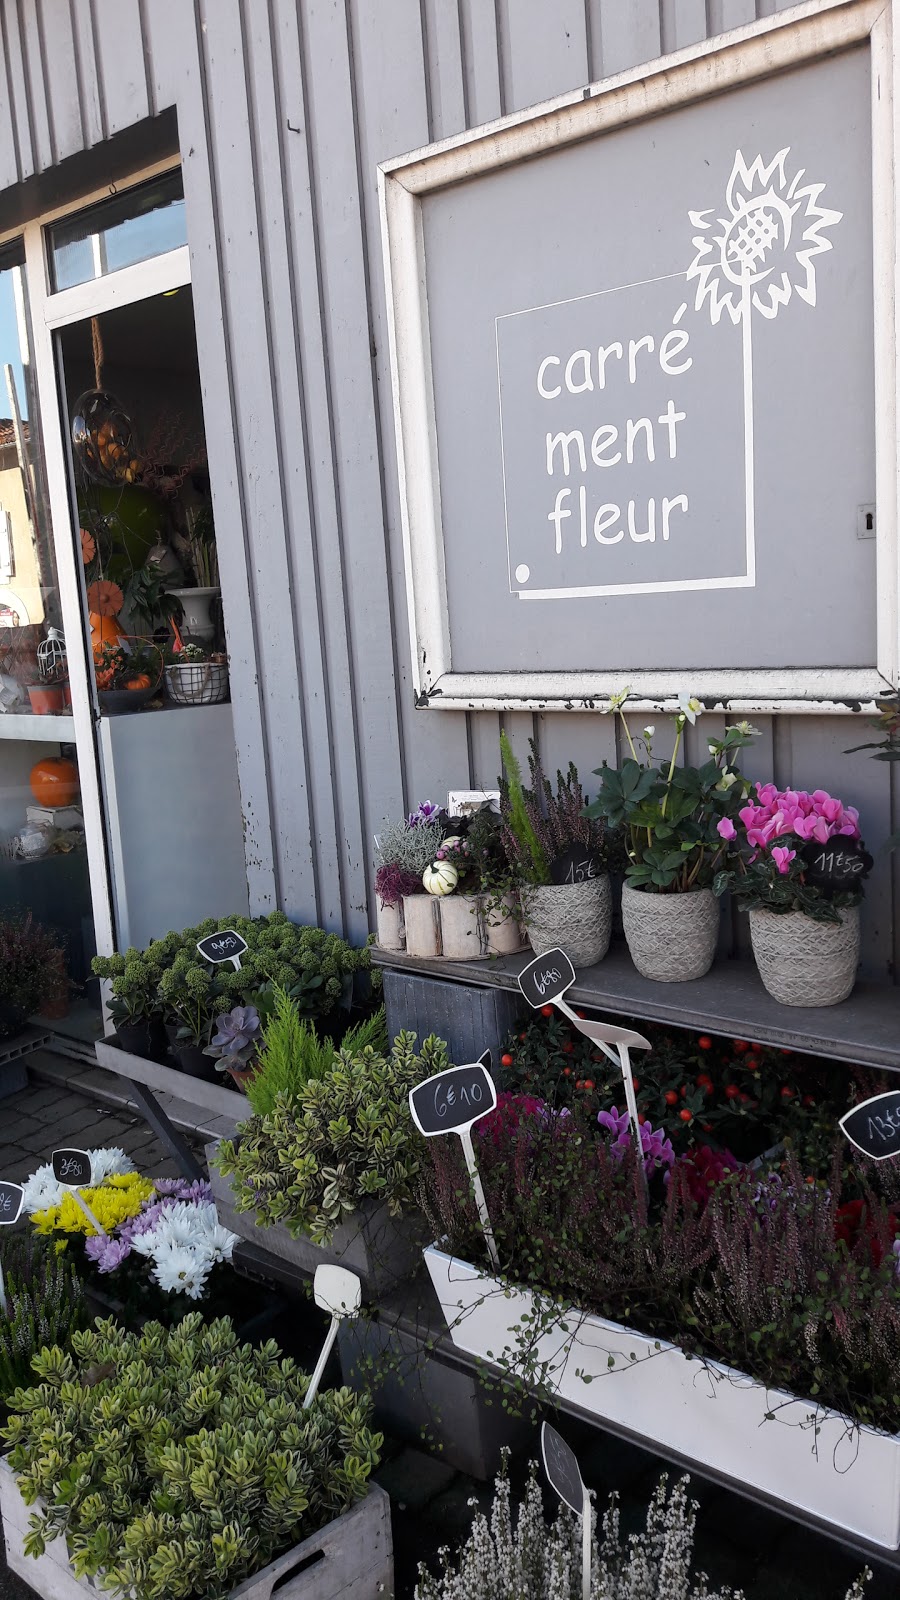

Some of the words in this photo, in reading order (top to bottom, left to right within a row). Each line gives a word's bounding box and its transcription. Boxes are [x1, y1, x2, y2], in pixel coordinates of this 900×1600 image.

[537, 302, 693, 399] carré
[546, 400, 686, 475] ment
[548, 486, 688, 553] fleur
[565, 858, 596, 883] 15€
[814, 852, 864, 873] 11€50
[211, 937, 237, 955] 9€50
[434, 1083, 483, 1117] 6€10
